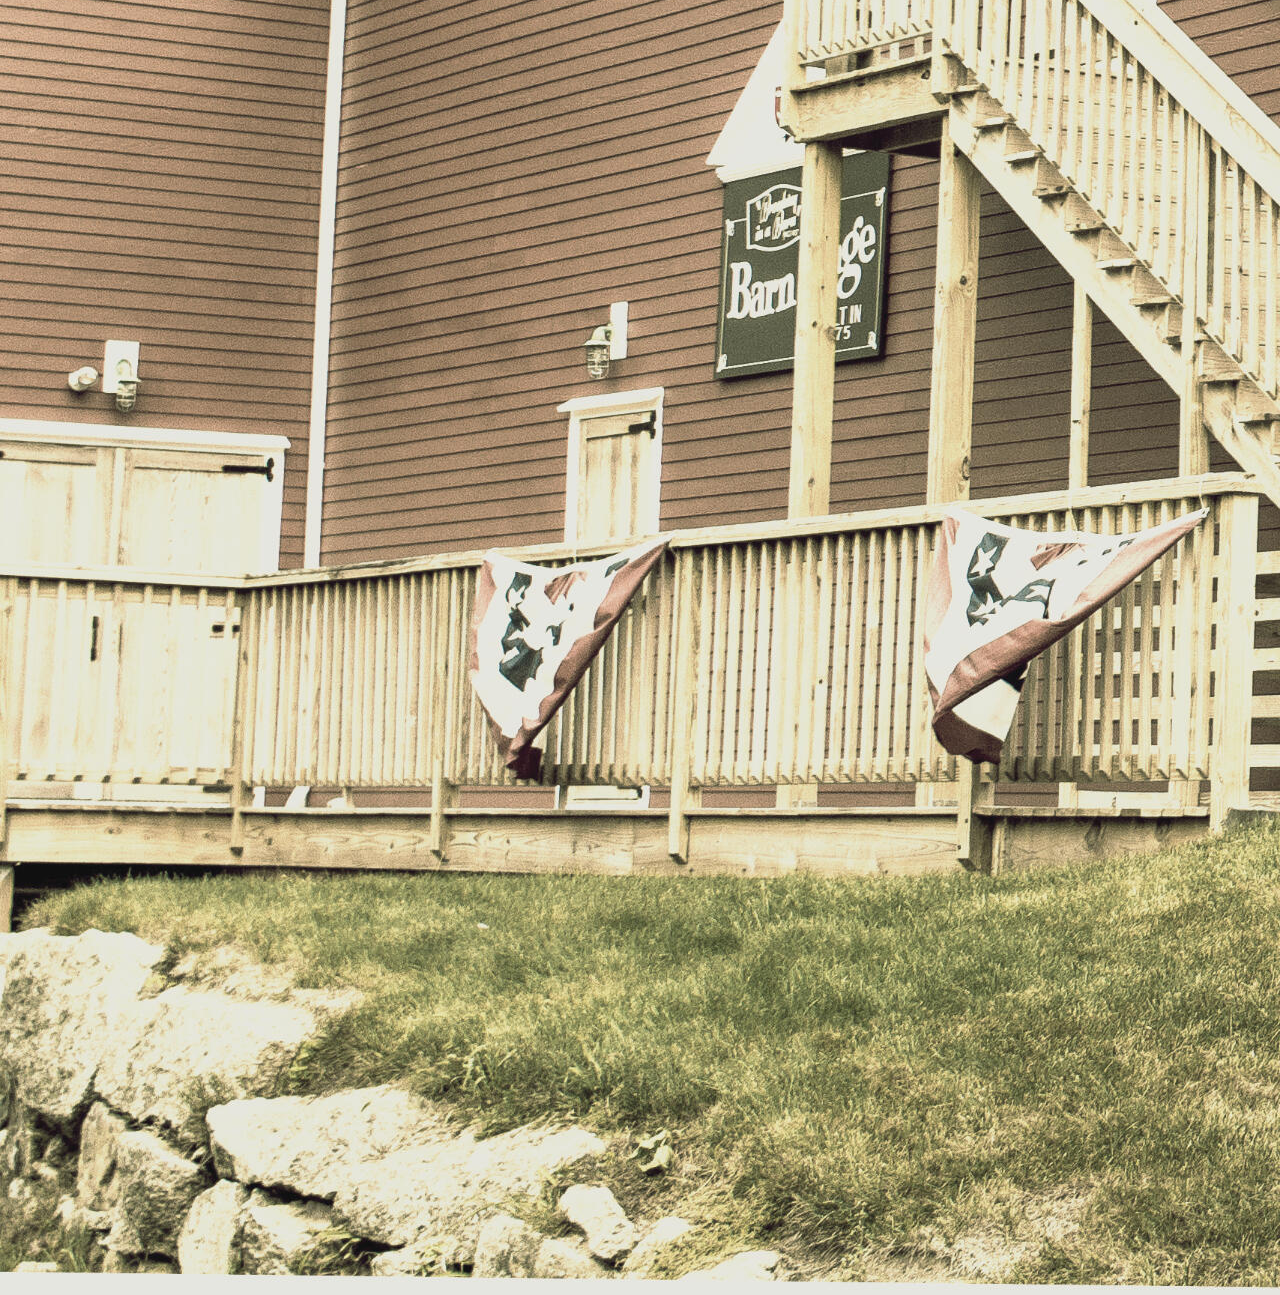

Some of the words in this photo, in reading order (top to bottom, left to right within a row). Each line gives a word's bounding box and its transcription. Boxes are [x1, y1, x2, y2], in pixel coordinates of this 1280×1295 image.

[726, 261, 798, 319] Barn
[849, 304, 862, 324] IN
[835, 325, 851, 341] 75
